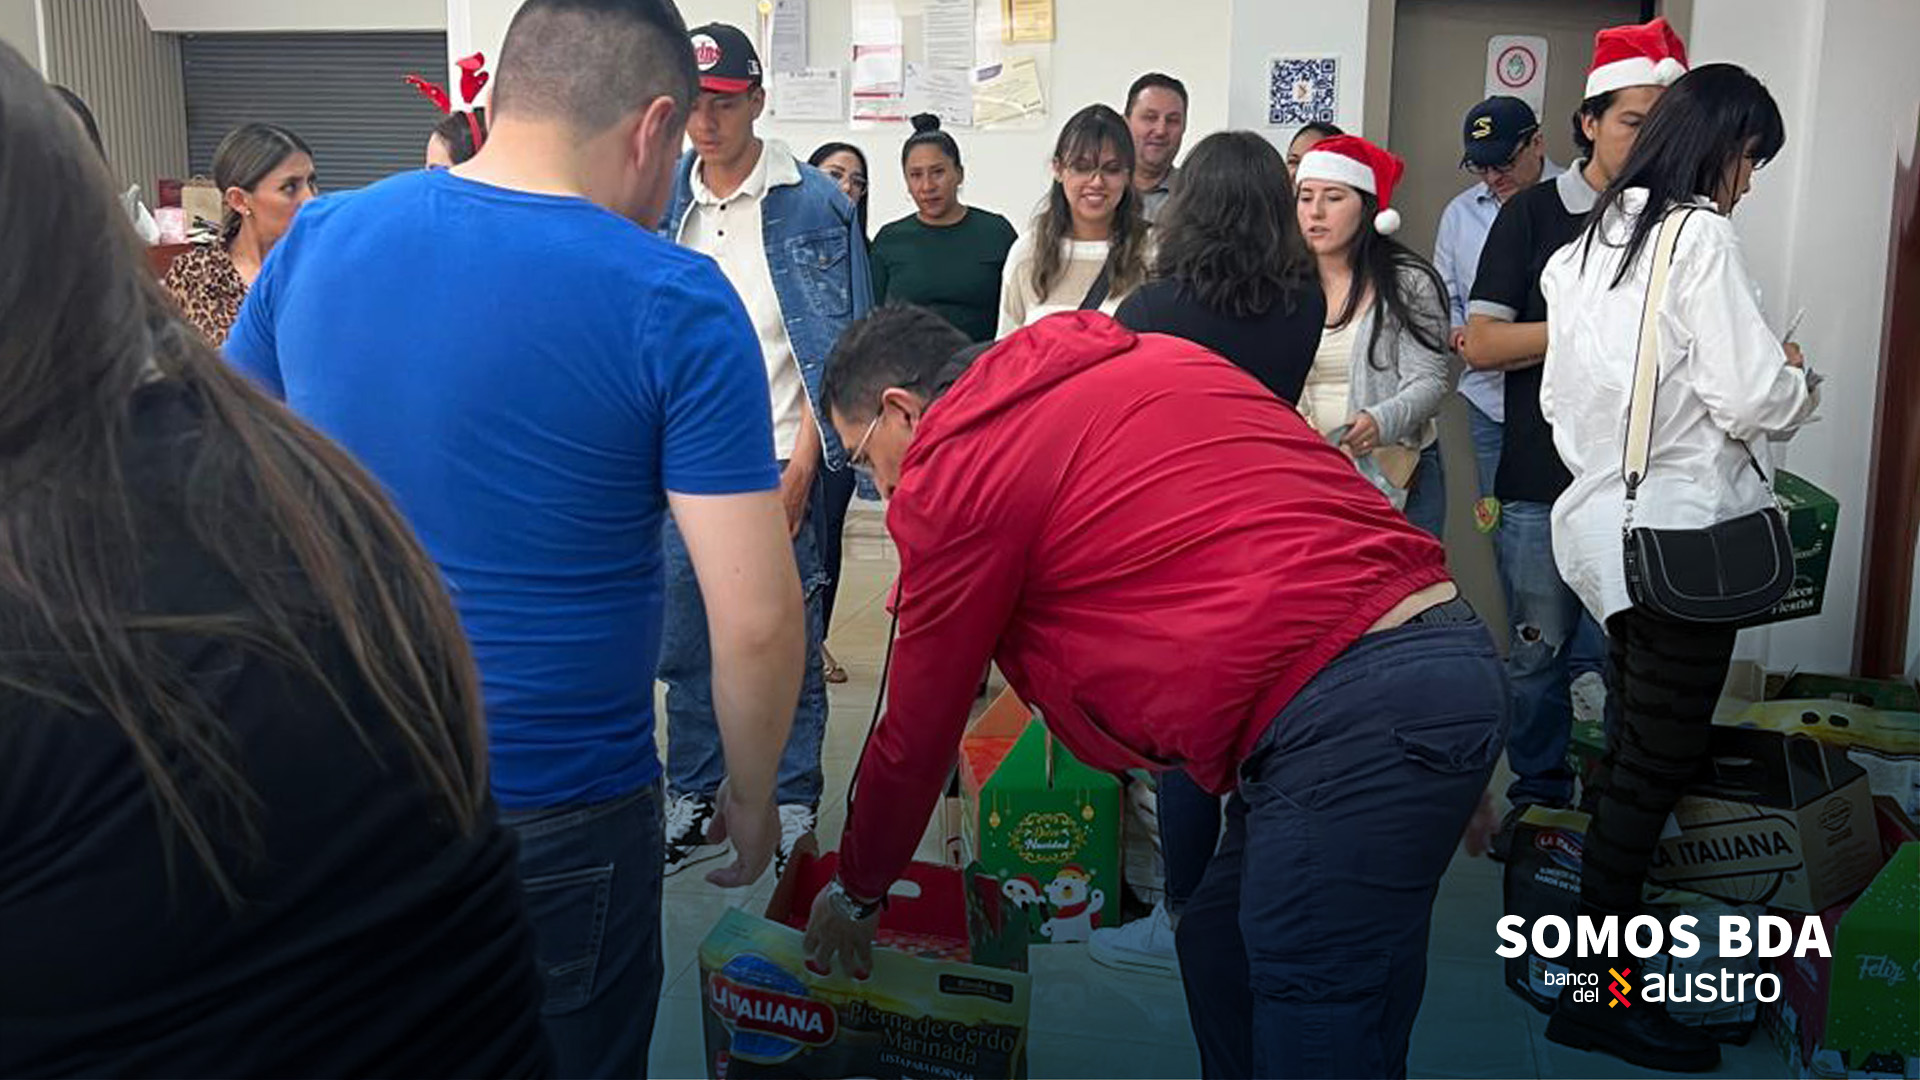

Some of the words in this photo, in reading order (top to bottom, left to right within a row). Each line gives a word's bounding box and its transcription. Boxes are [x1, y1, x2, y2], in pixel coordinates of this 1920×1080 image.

[1024, 838, 1069, 850] Navidad
[1678, 831, 1792, 865] ITALIANA
[1856, 954, 1907, 986] Feliz
[712, 984, 728, 1008] LA
[729, 992, 825, 1035] ITALIANA
[850, 1001, 912, 1032] Pierna
[917, 1015, 944, 1039] de
[948, 1023, 1016, 1052] Cerdo
[884, 1028, 979, 1066] Marinada
